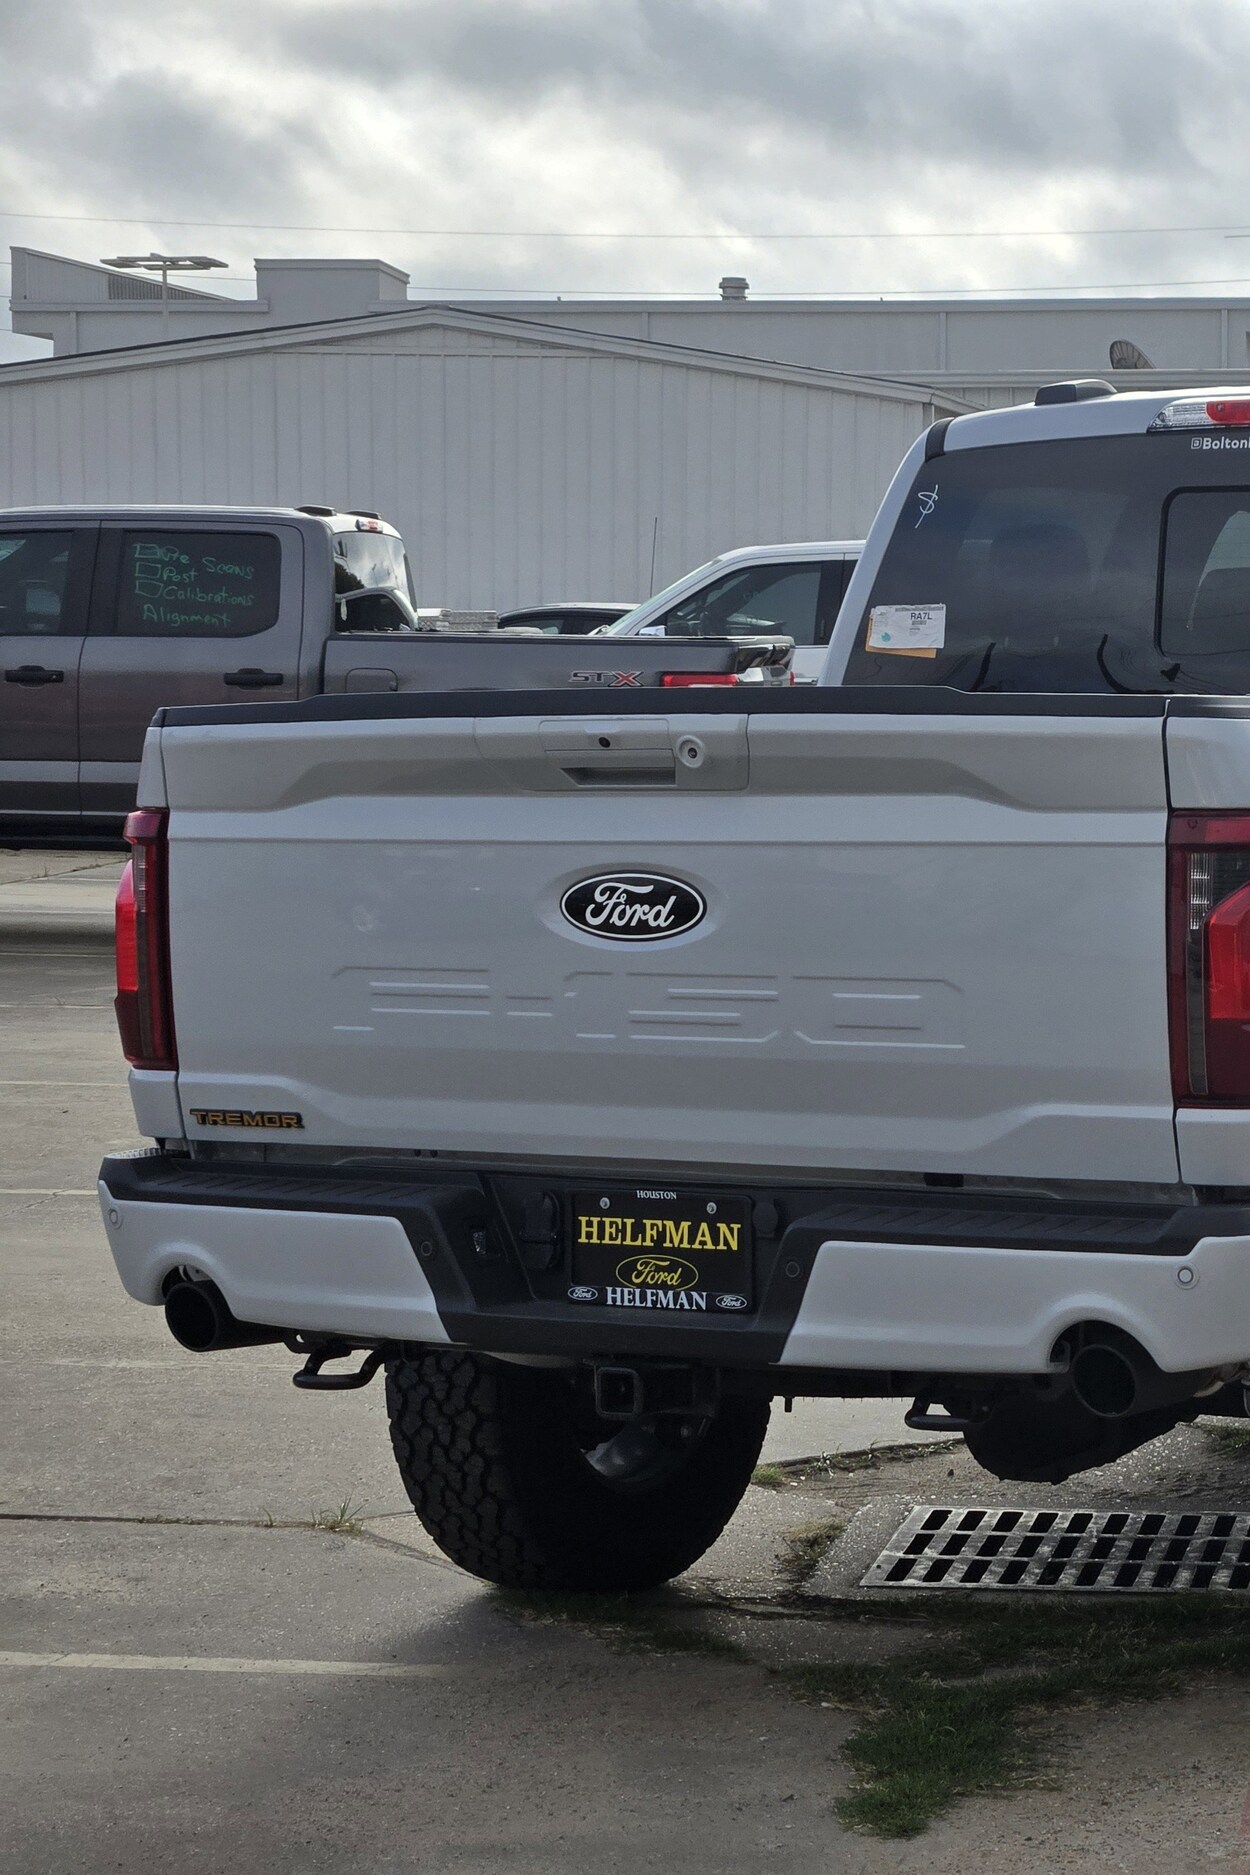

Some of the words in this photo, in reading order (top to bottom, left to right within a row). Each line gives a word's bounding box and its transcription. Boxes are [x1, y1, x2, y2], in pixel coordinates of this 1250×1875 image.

[163, 566, 198, 583] Post
[143, 603, 231, 627] Alignment
[910, 612, 933, 620] RA7L
[568, 670, 644, 687] STX
[585, 882, 677, 928] Ford
[190, 1108, 304, 1128] TREMOR
[636, 1190, 677, 1200] HOUSTON
[577, 1216, 741, 1251] HELFMAN
[631, 1258, 683, 1286] Ford
[606, 1286, 707, 1310] HELFMAN
